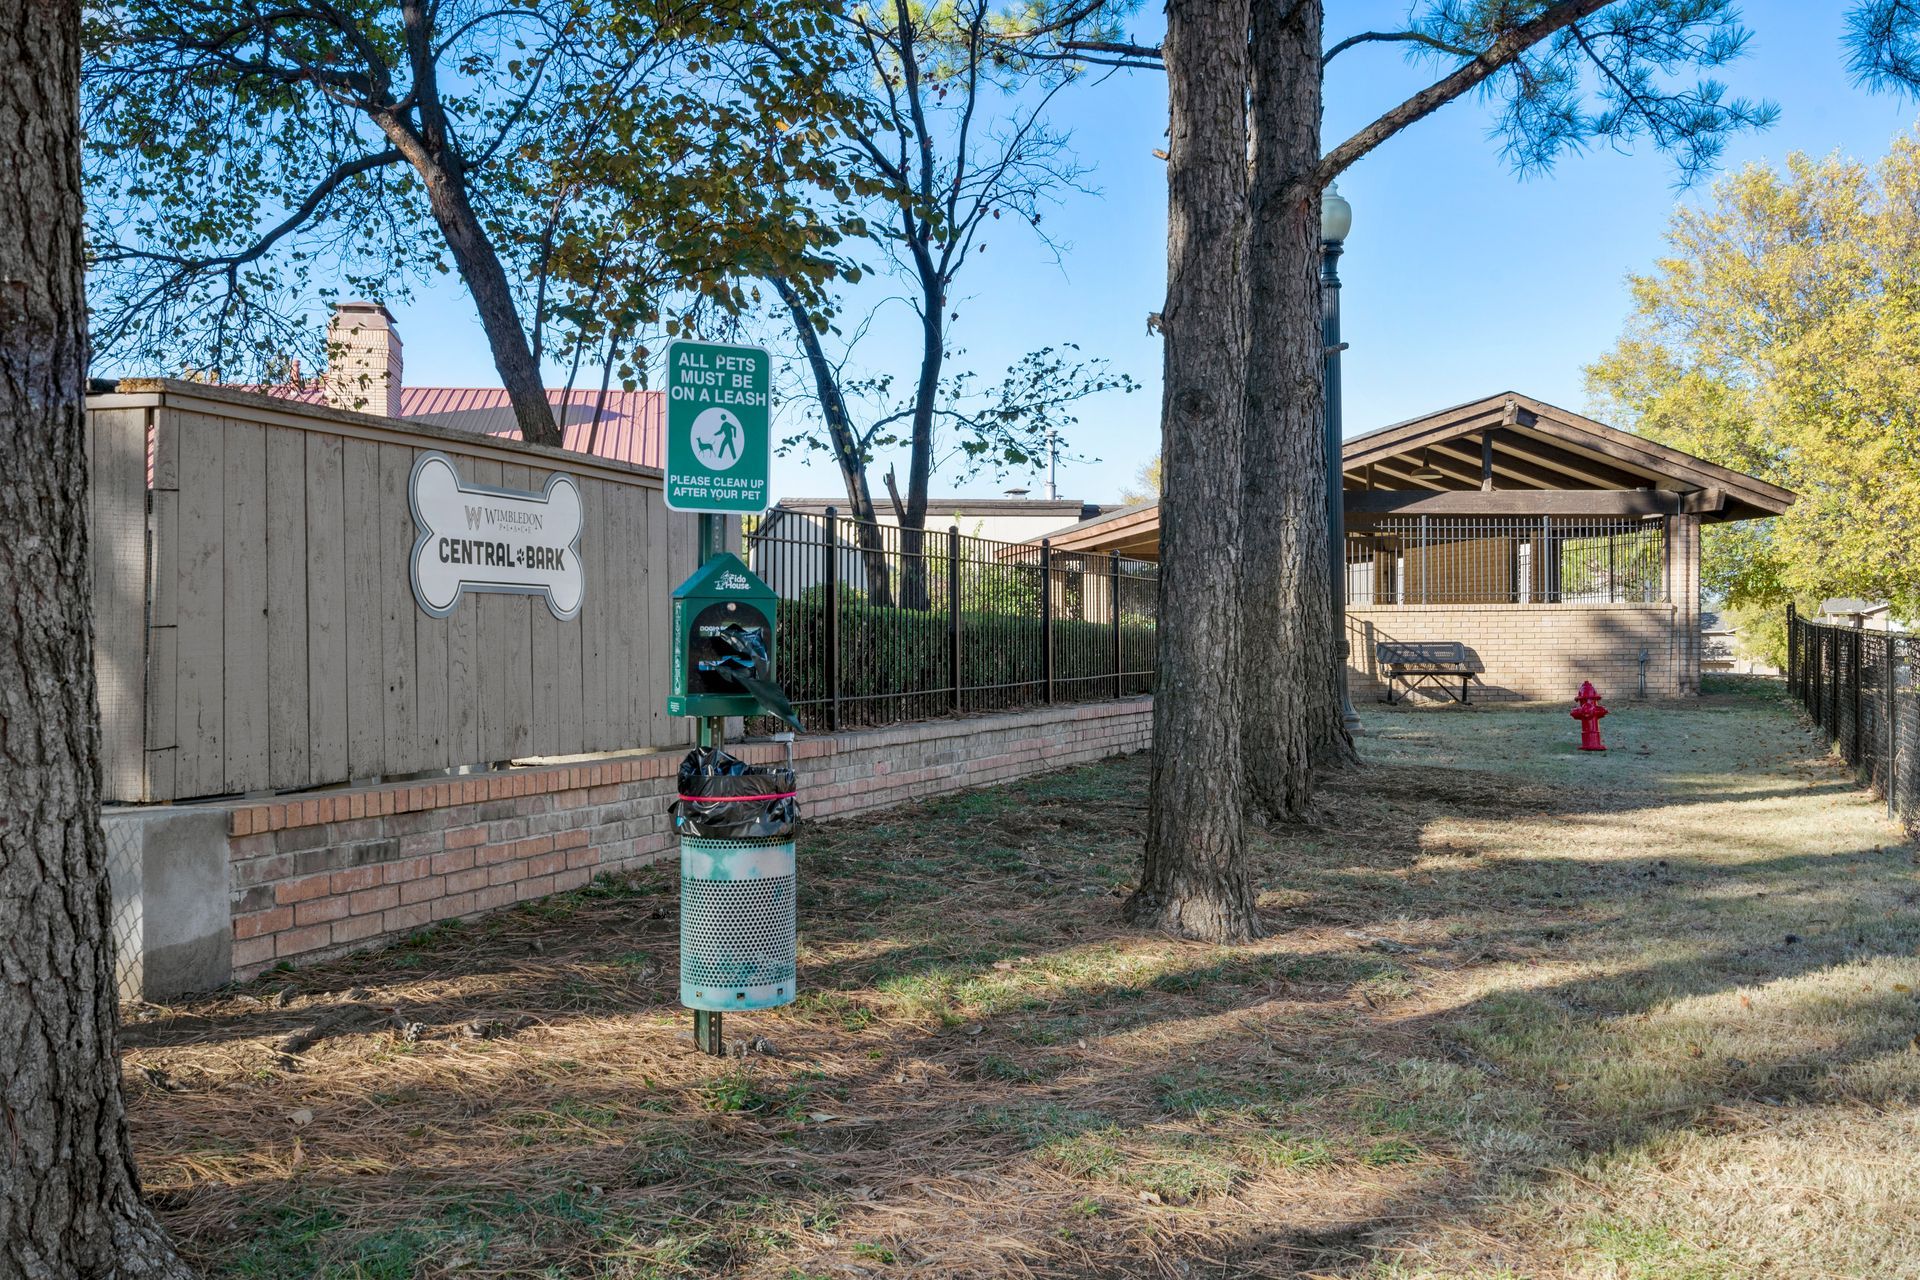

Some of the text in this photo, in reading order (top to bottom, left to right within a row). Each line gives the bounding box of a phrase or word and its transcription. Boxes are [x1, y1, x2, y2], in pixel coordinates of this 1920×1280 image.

[678, 352, 756, 372] ALL PETS
[681, 369, 753, 389] MUST BE
[671, 386, 766, 406] ON A LEASH
[670, 474, 764, 489] PLEASE CLEAN UP
[673, 486, 761, 501] AFTER YOUR PET
[484, 508, 543, 531] WIMBLEDON
[438, 537, 565, 571] CENTRAL BARK
[725, 581, 750, 590] House
[728, 573, 747, 583] Fido
